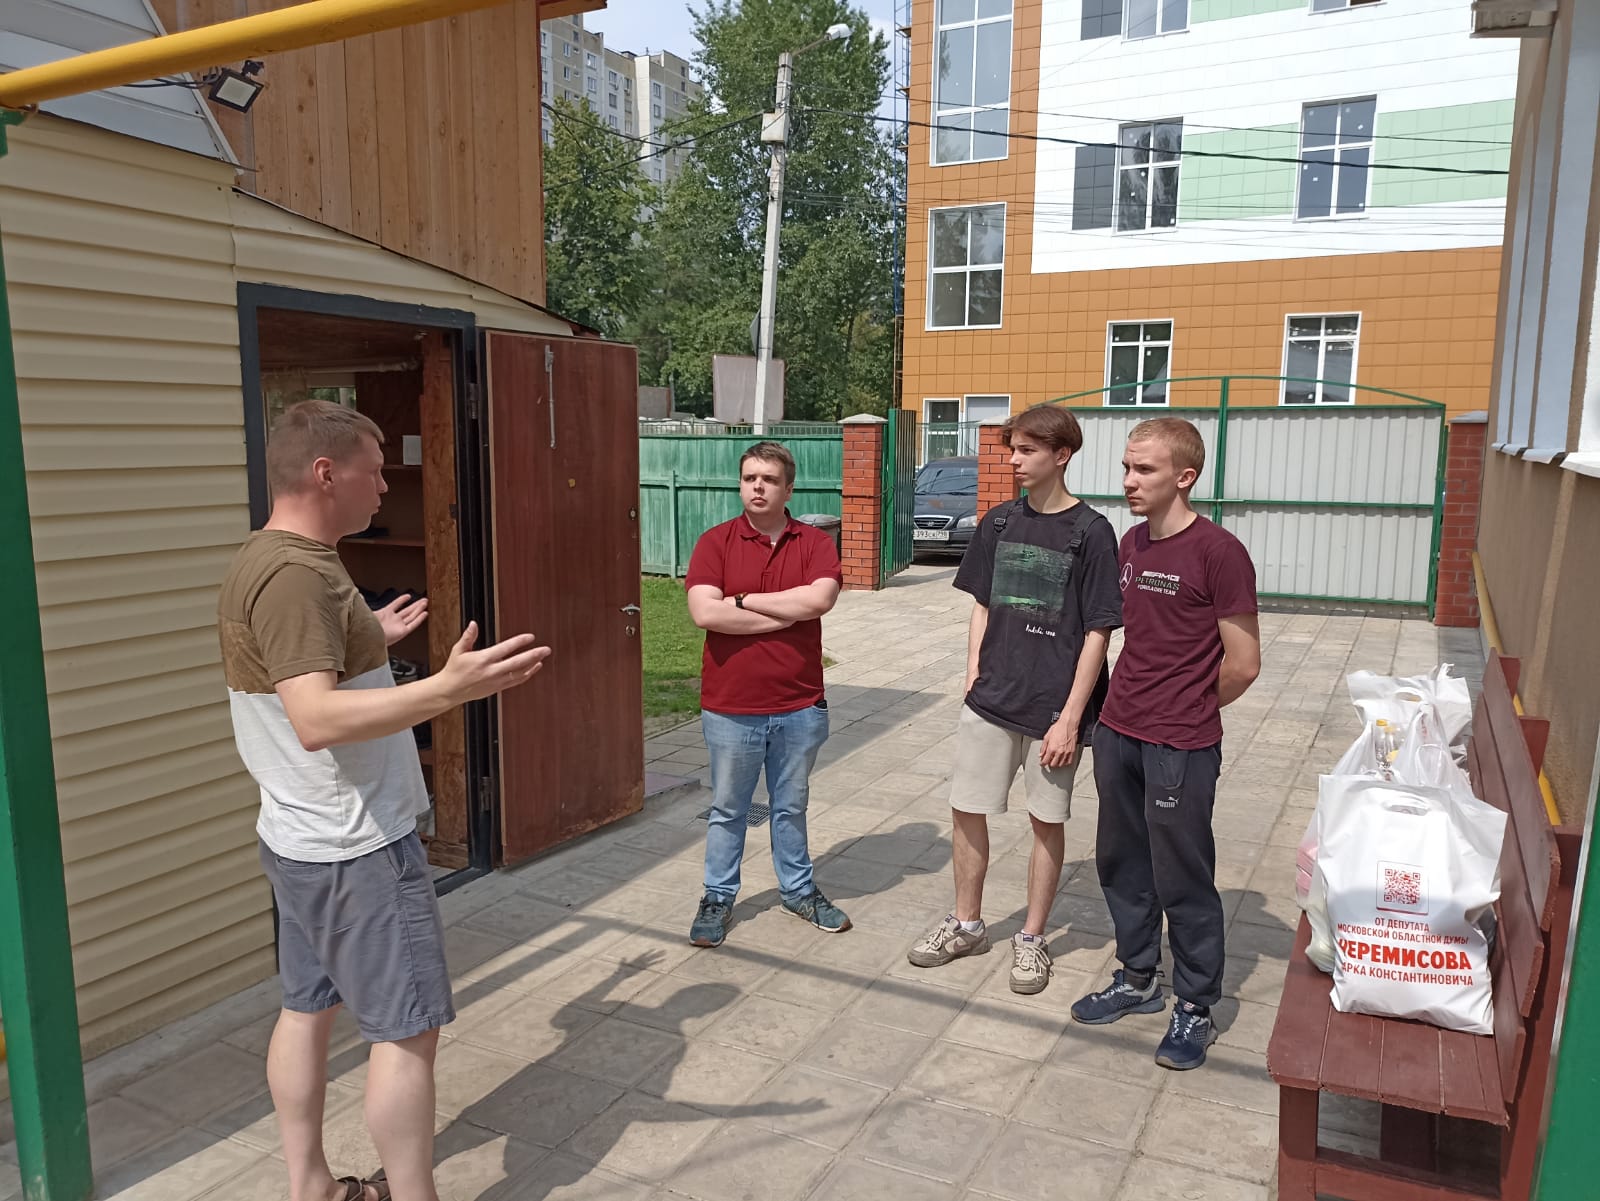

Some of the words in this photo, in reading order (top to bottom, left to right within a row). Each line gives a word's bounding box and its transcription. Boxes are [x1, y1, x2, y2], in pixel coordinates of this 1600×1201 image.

[1135, 576, 1180, 591] PETRONAS
[1374, 917, 1385, 926] ОТ
[1387, 919, 1430, 932] ДЕПУТАТА
[1337, 923, 1389, 939] МОСКОВСКОЙ
[1392, 930, 1442, 944] ОБЛАСТНОЙ
[1443, 935, 1469, 945] ДУМЫ
[1342, 962, 1367, 976] АРКА
[1369, 966, 1473, 986] КОНСТАНТИНОВИЧА
